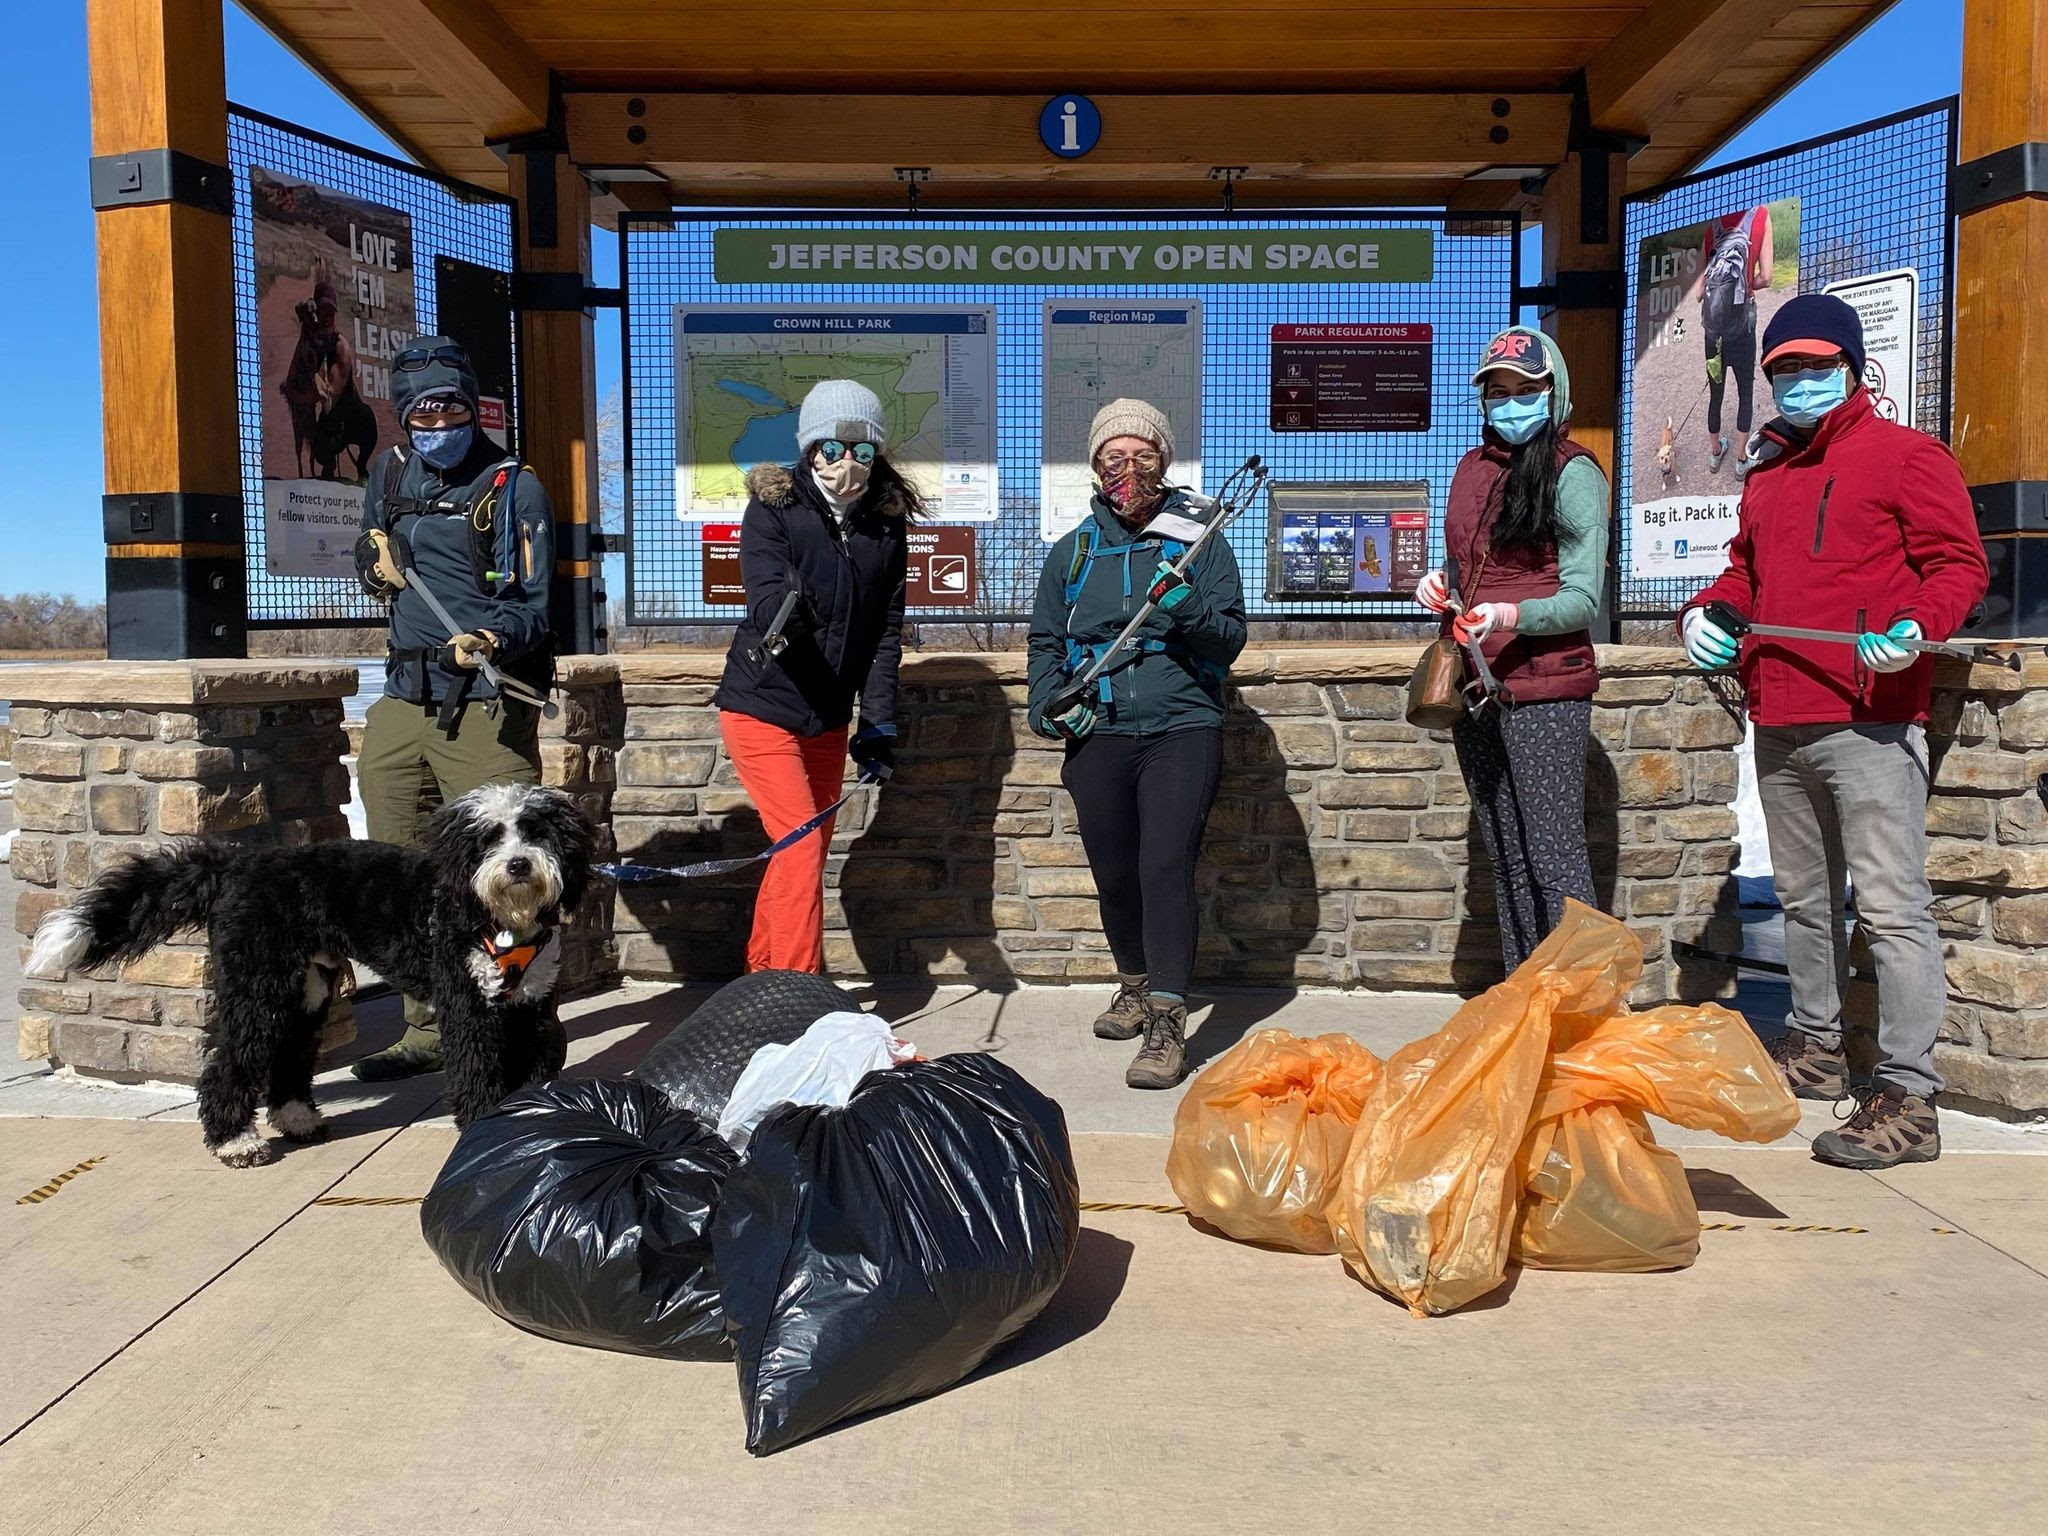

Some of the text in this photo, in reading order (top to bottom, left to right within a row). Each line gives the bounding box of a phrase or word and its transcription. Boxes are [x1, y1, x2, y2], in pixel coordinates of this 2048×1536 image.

[349, 223, 398, 272] LOVE
[768, 243, 1380, 272] JEFFERSON COUNTY OPEN SPACE
[1650, 247, 1698, 284] LET'S
[352, 266, 386, 309] 'EM
[1648, 285, 1682, 317] DOO
[1088, 310, 1156, 325] Region Map
[1869, 307, 1899, 316] MARIJUANA
[1876, 315, 1894, 323] MINOR
[773, 318, 892, 330] CROWN HILL PARK
[1294, 327, 1408, 337] PARK REGULATIONS
[1303, 349, 1315, 357] day
[356, 359, 390, 401] 'EM
[289, 491, 360, 510] Protect your pet,
[278, 508, 305, 522] fellow
[306, 511, 341, 525] visitors.
[1643, 509, 1666, 527] Bag
[1668, 506, 1682, 522] it.
[1685, 503, 1715, 521] Pack
[1718, 502, 1732, 519] it.
[906, 534, 940, 543] SHING
[1689, 543, 1718, 552] Lakewood
